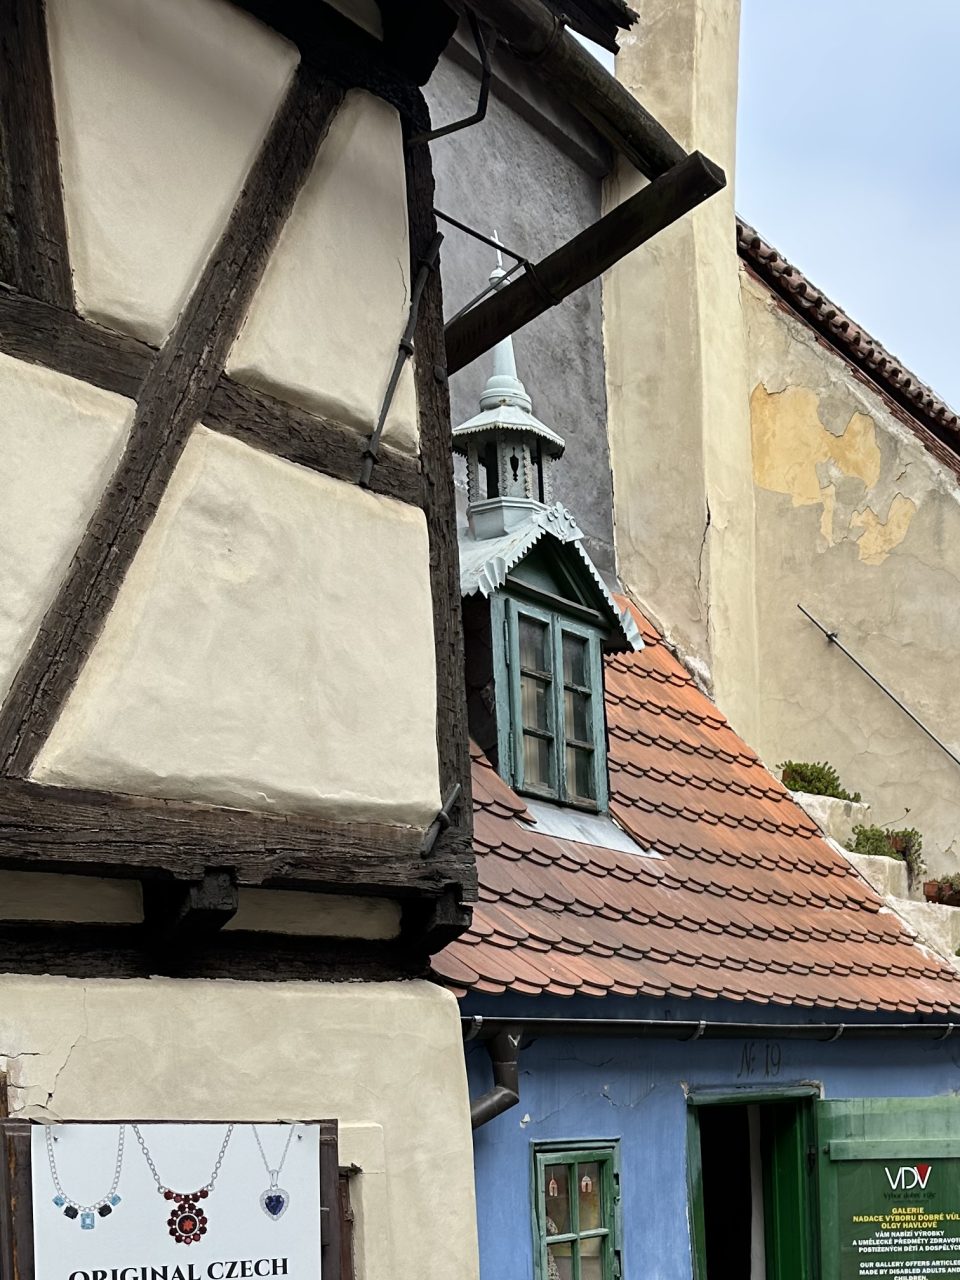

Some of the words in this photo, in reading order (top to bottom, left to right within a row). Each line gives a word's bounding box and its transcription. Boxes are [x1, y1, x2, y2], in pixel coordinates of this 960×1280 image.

[764, 1042, 782, 1078] 19
[884, 1164, 932, 1190] VDV
[885, 1213, 916, 1221] VÝBORU
[918, 1213, 944, 1221] DOBRÉ
[875, 1230, 890, 1238] VÁM
[207, 1258, 289, 1280] CZECH
